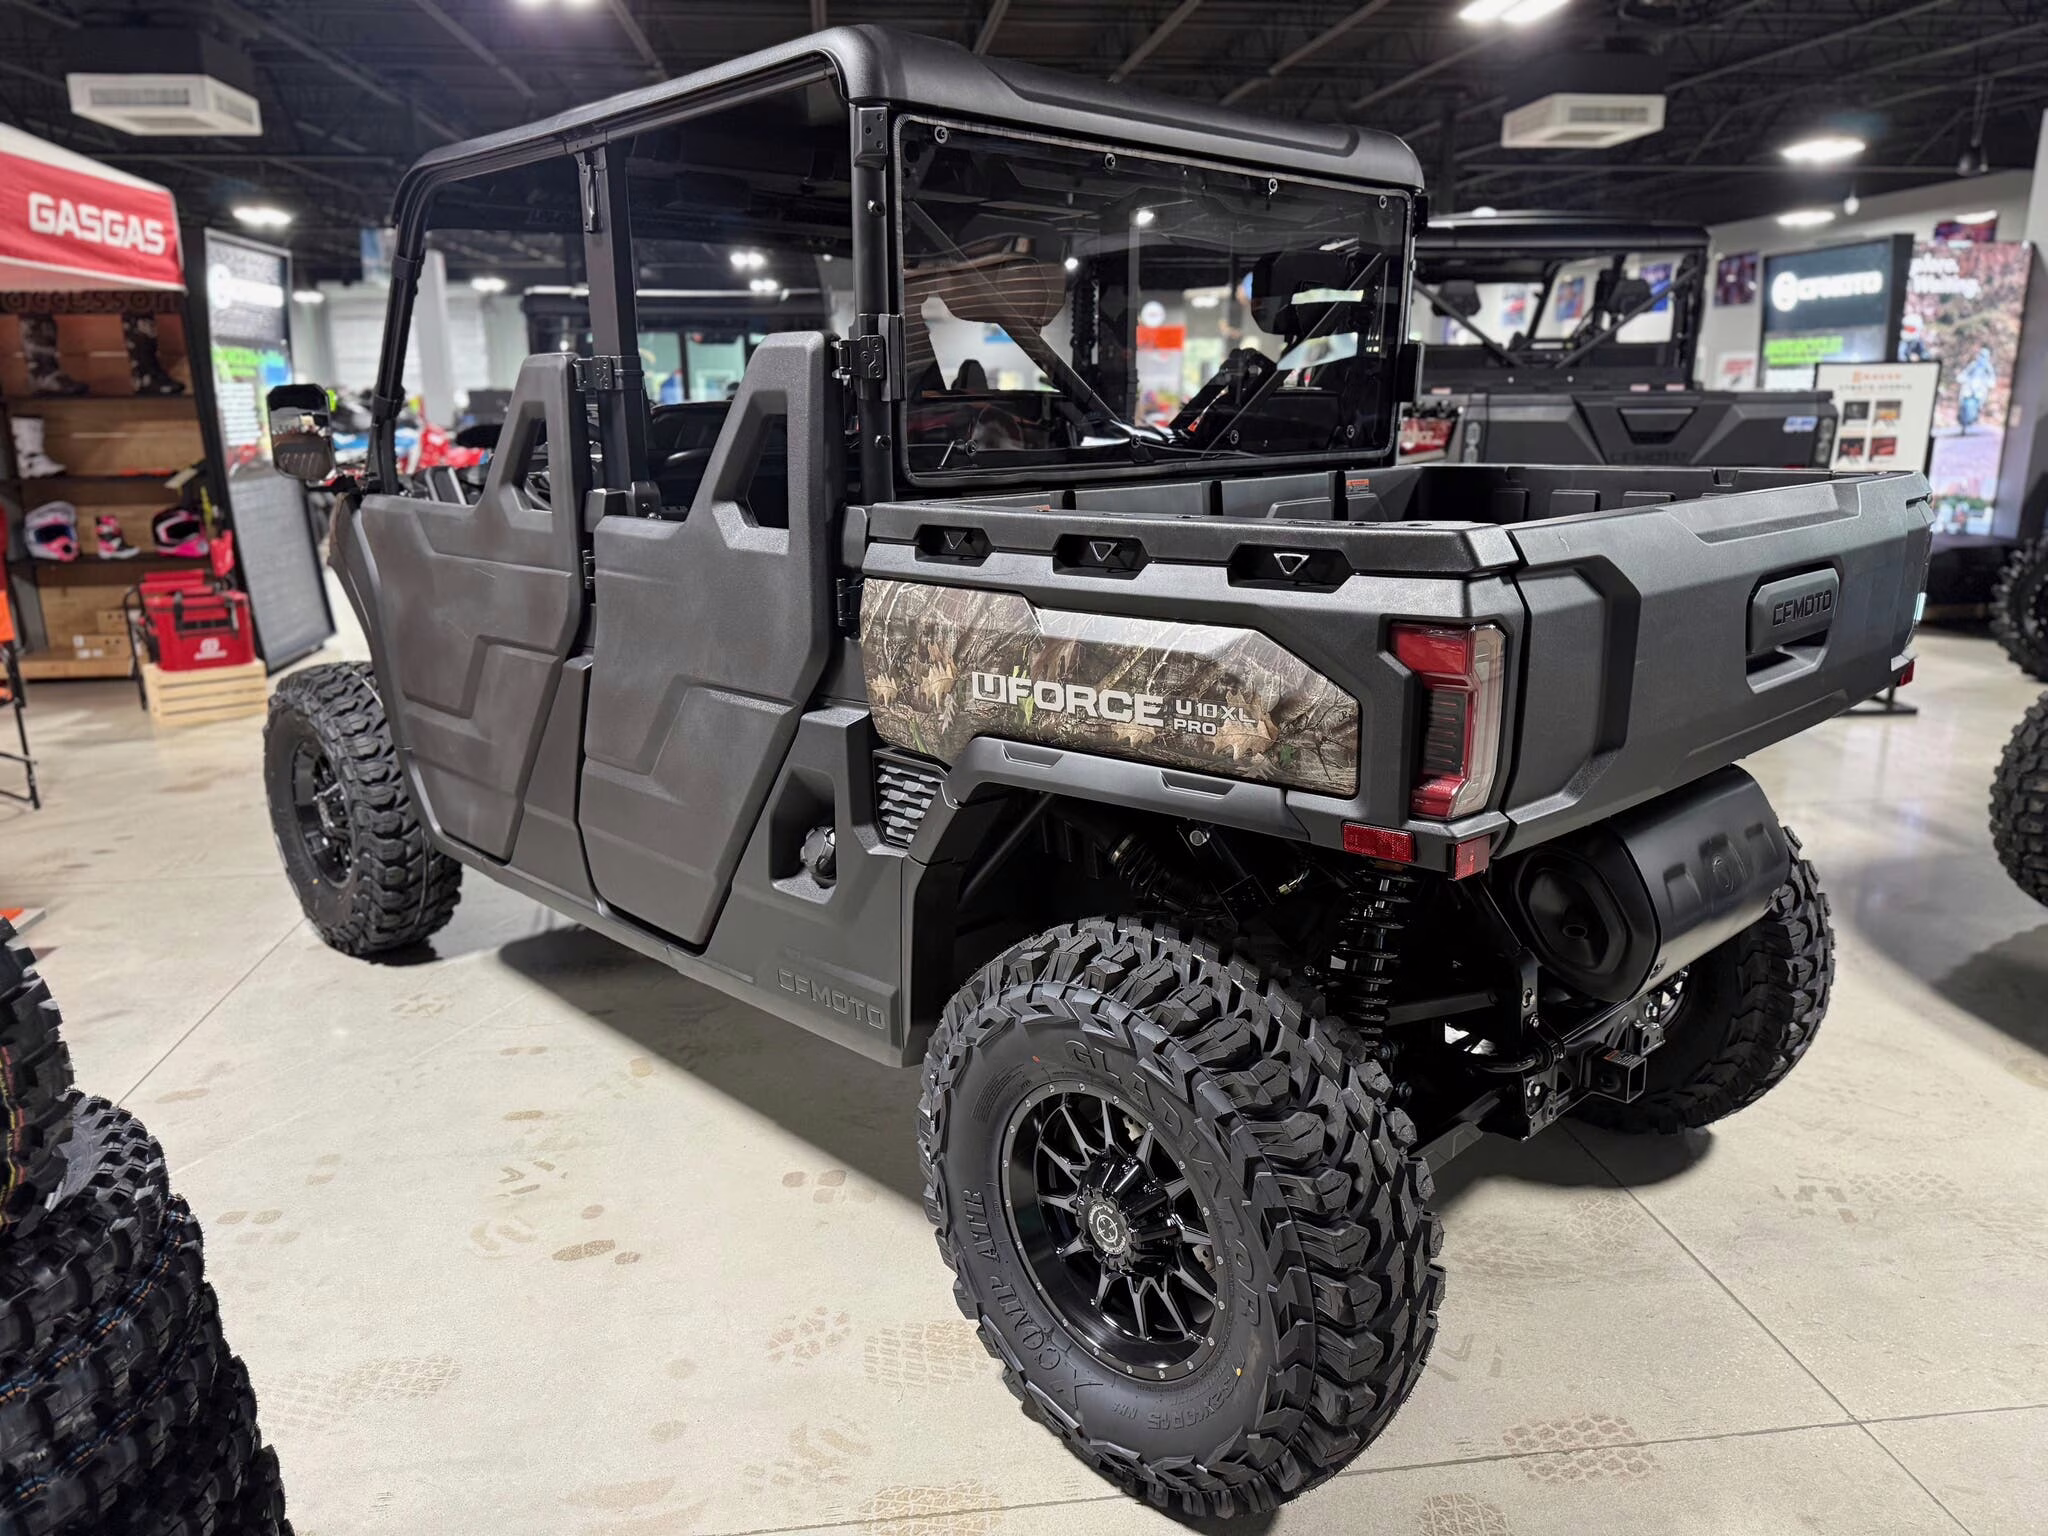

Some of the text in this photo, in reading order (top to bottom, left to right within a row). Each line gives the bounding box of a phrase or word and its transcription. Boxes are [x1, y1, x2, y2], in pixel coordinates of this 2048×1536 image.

[28, 191, 167, 256] GASGAS
[1772, 589, 1833, 627] CFMOTO
[971, 671, 1164, 727] UFORCE
[1173, 718, 1218, 736] PRO
[777, 967, 886, 1030] CFMOTO
[1065, 1039, 1261, 1328] GLADIATOR
